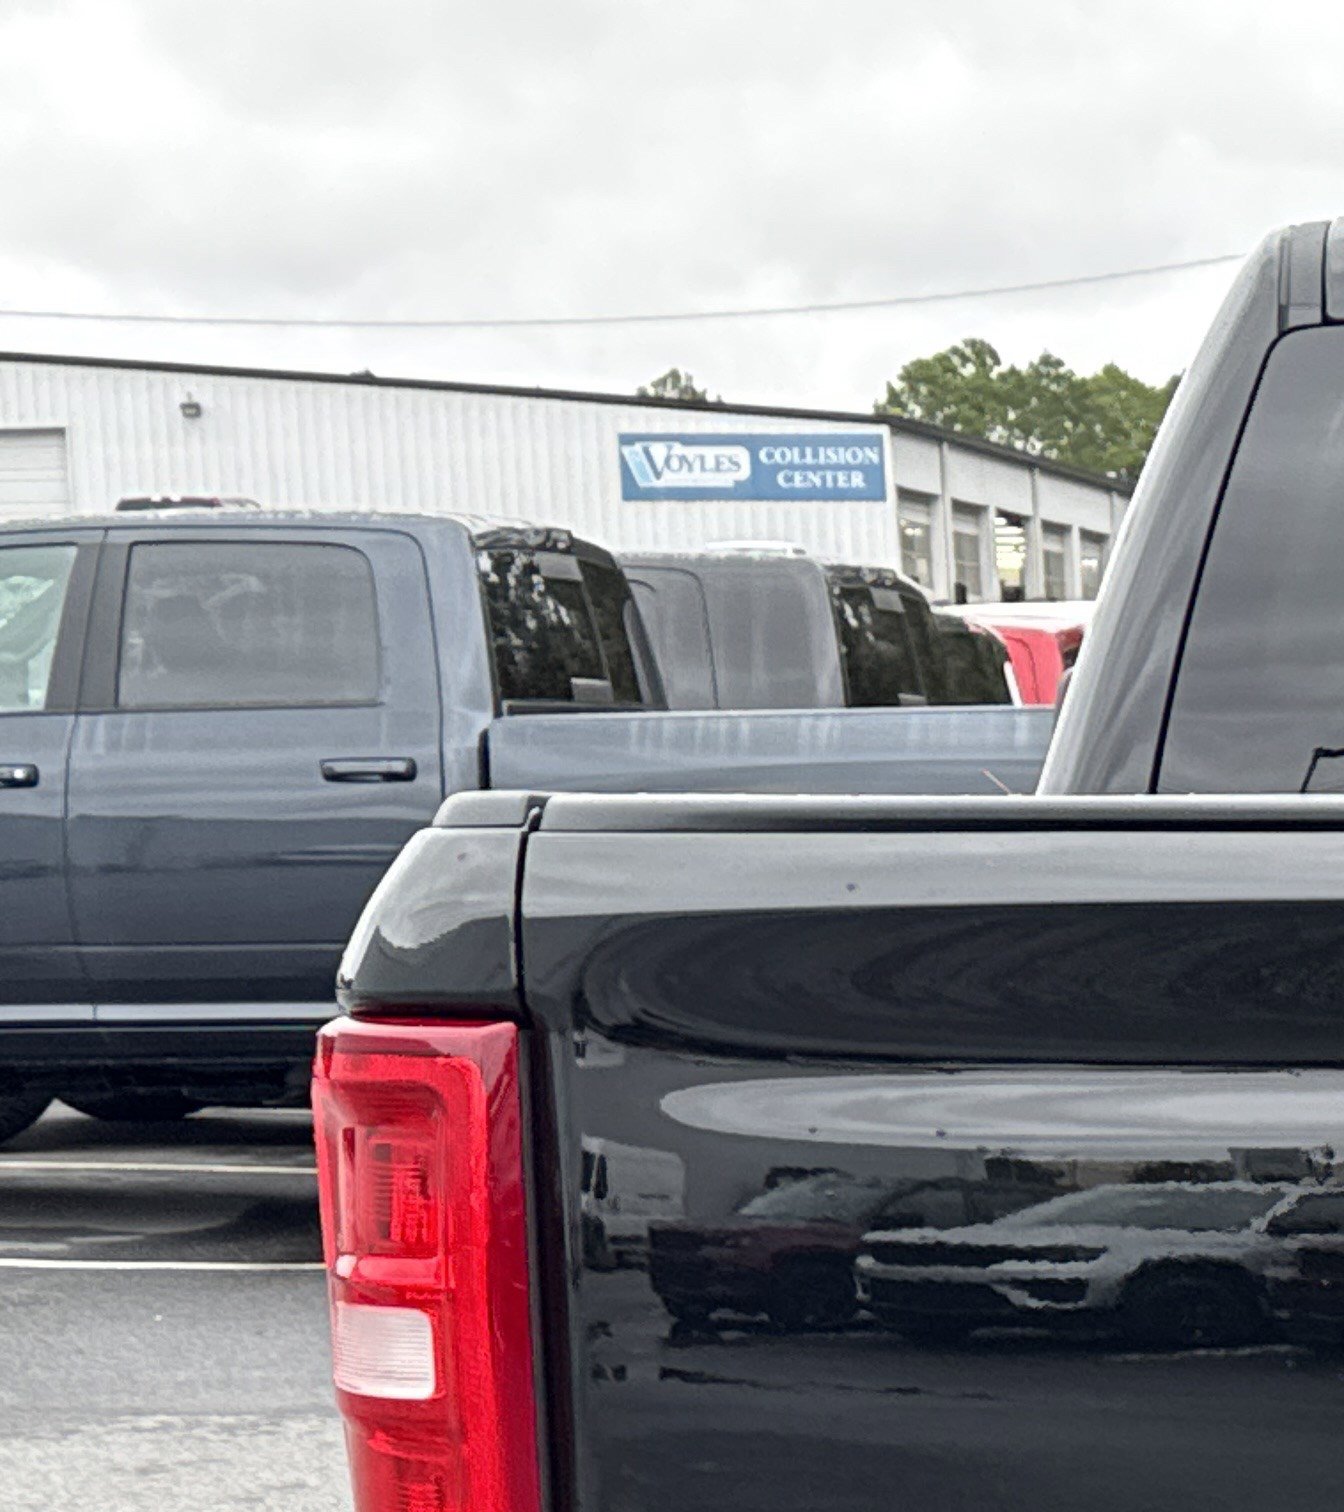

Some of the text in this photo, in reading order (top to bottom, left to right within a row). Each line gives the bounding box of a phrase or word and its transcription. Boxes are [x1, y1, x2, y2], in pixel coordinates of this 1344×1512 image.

[641, 443, 741, 481] VOYLES
[758, 446, 880, 465] COLLISION
[777, 471, 866, 488] CENTER
